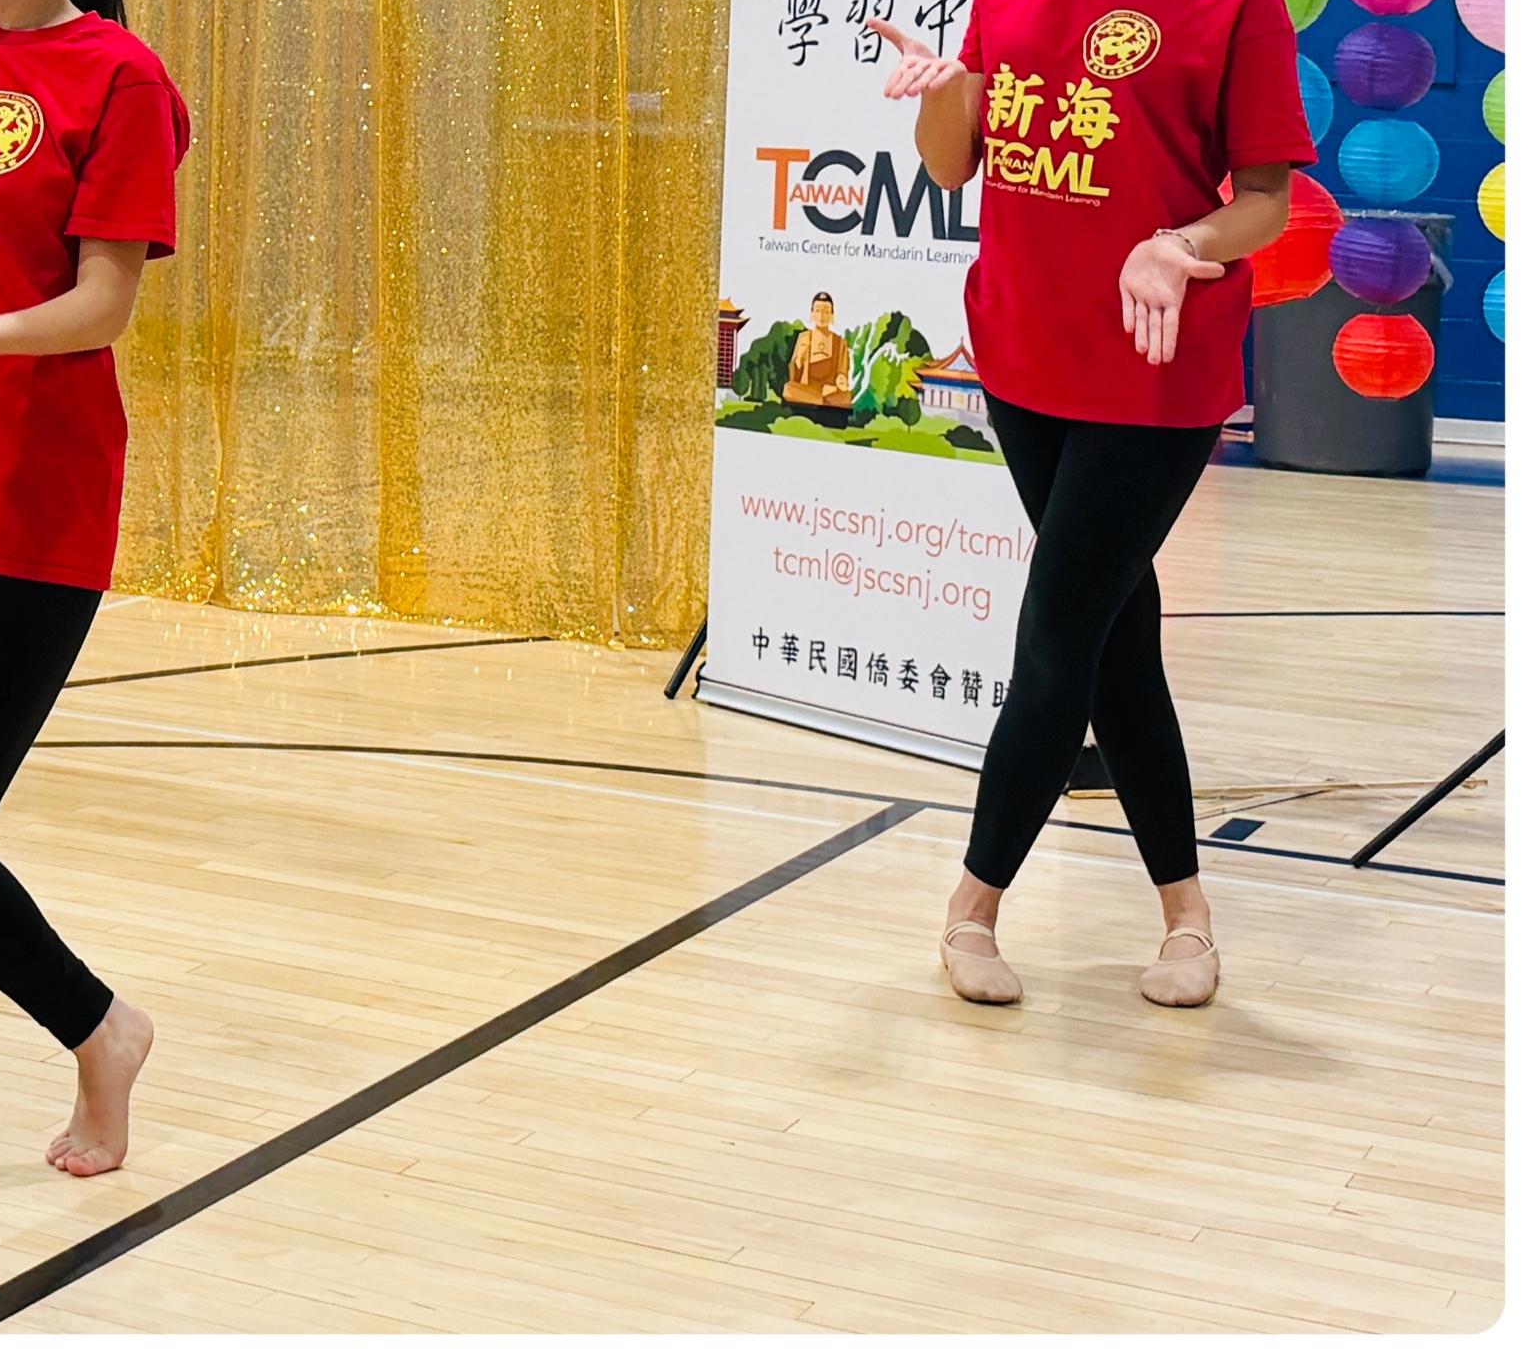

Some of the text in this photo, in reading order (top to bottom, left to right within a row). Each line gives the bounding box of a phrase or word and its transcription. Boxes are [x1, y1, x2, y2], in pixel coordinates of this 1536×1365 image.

[986, 62, 1121, 150] 新海
[984, 136, 1110, 198] TCML
[758, 236, 800, 254] Taiwan
[801, 239, 843, 257] Center
[844, 241, 861, 257] for
[863, 243, 923, 262] Mandarin
[741, 494, 1038, 563] www.jscsnj.org/tcml/
[773, 546, 992, 621] tcml@jscsnj.org
